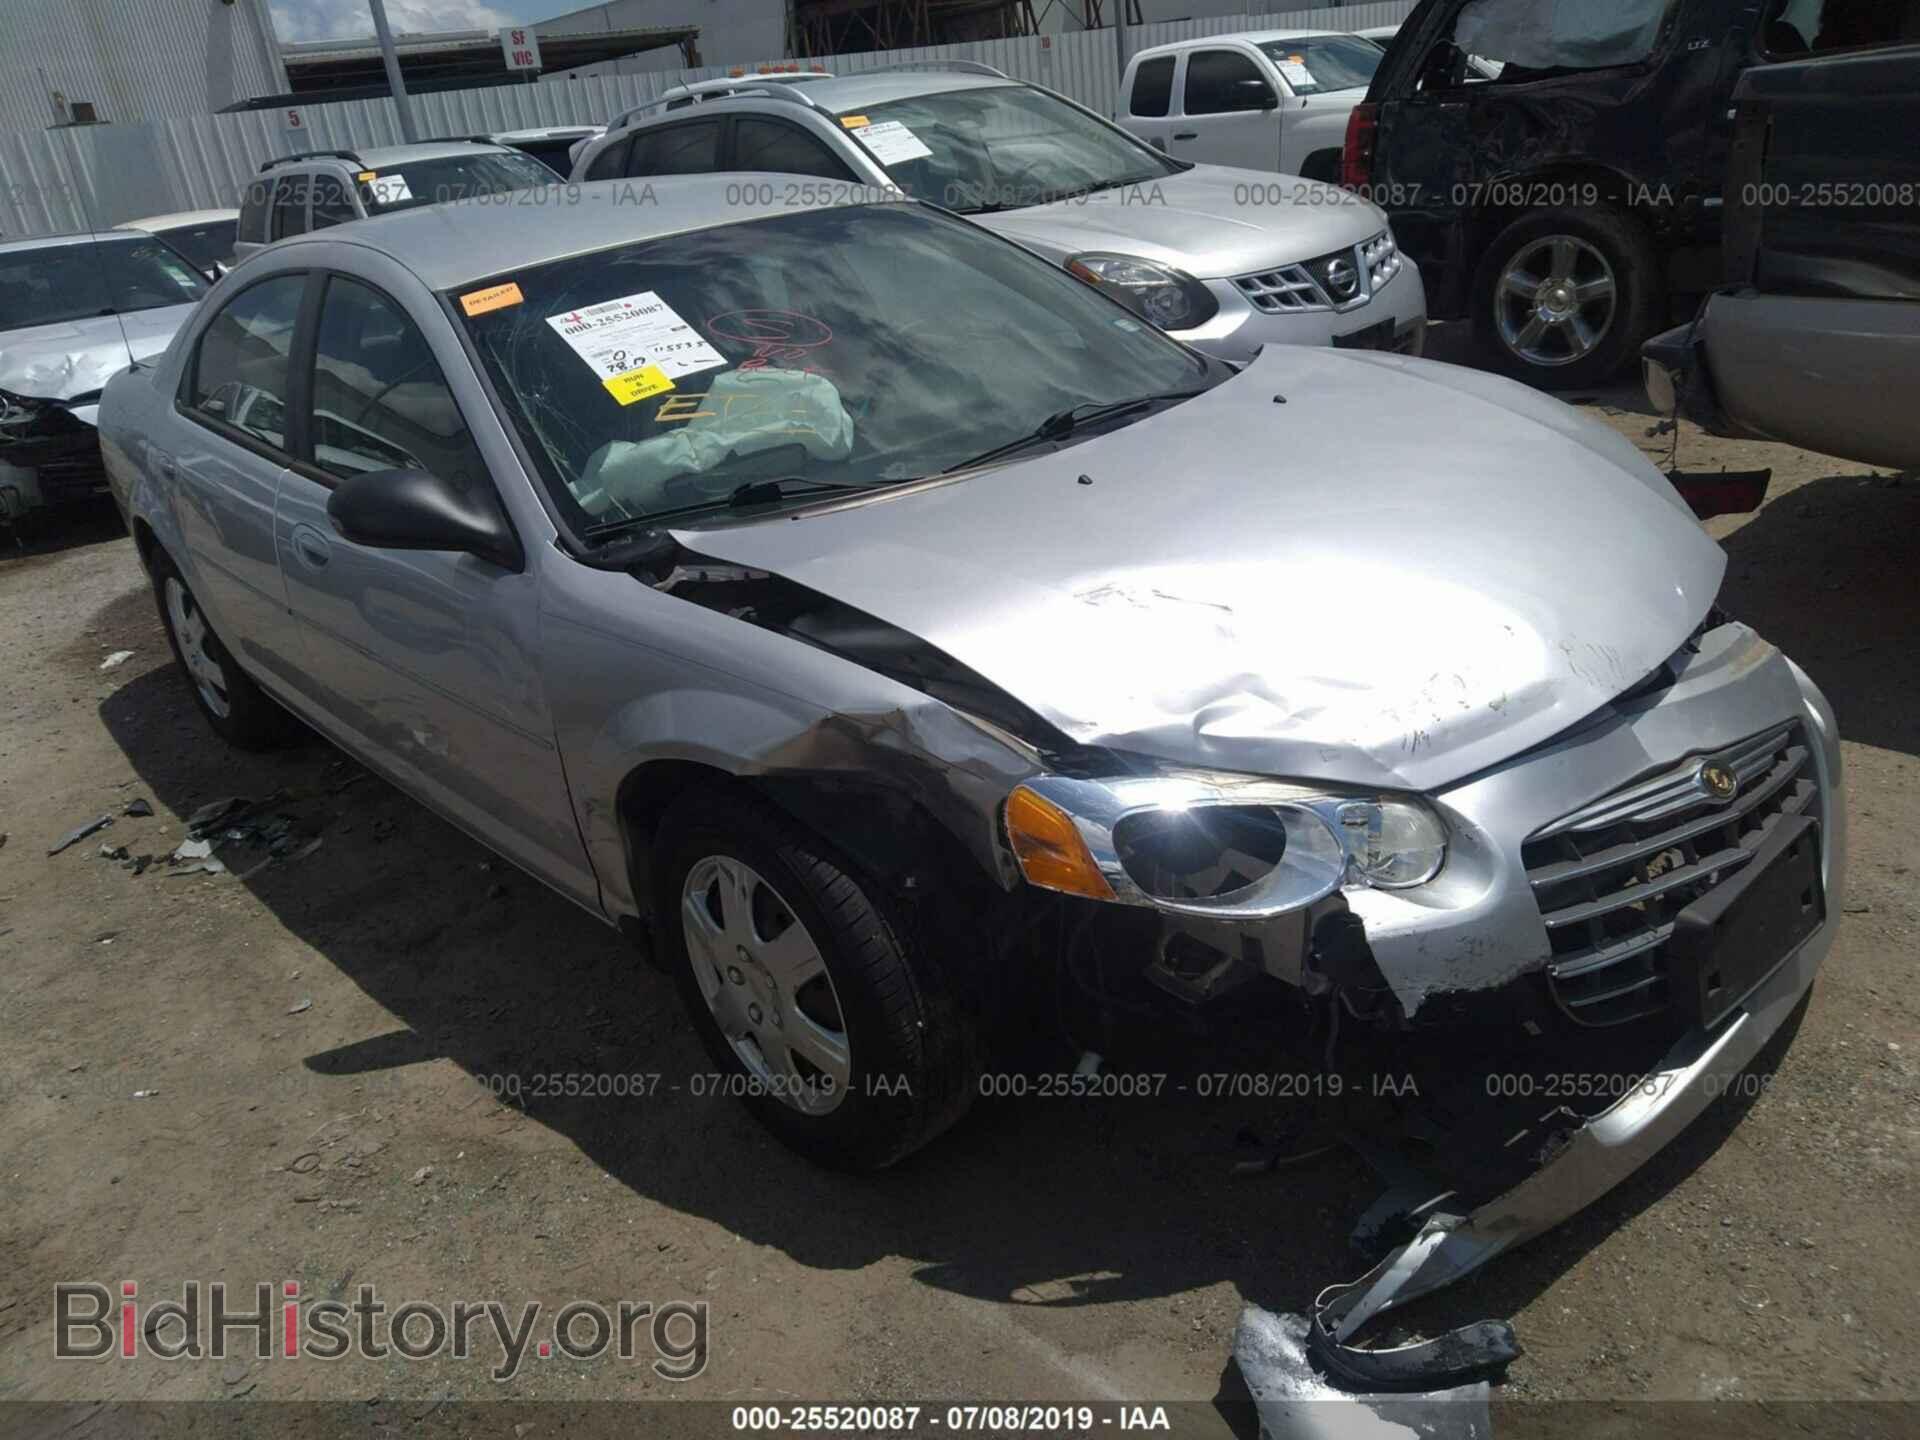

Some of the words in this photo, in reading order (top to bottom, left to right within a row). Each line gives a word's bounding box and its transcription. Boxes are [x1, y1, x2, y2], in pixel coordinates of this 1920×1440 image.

[511, 30, 526, 45] SF
[512, 50, 533, 65] VIC
[288, 111, 300, 127] 5
[564, 303, 664, 335] 000-25520087
[631, 384, 659, 397] DRIVE
